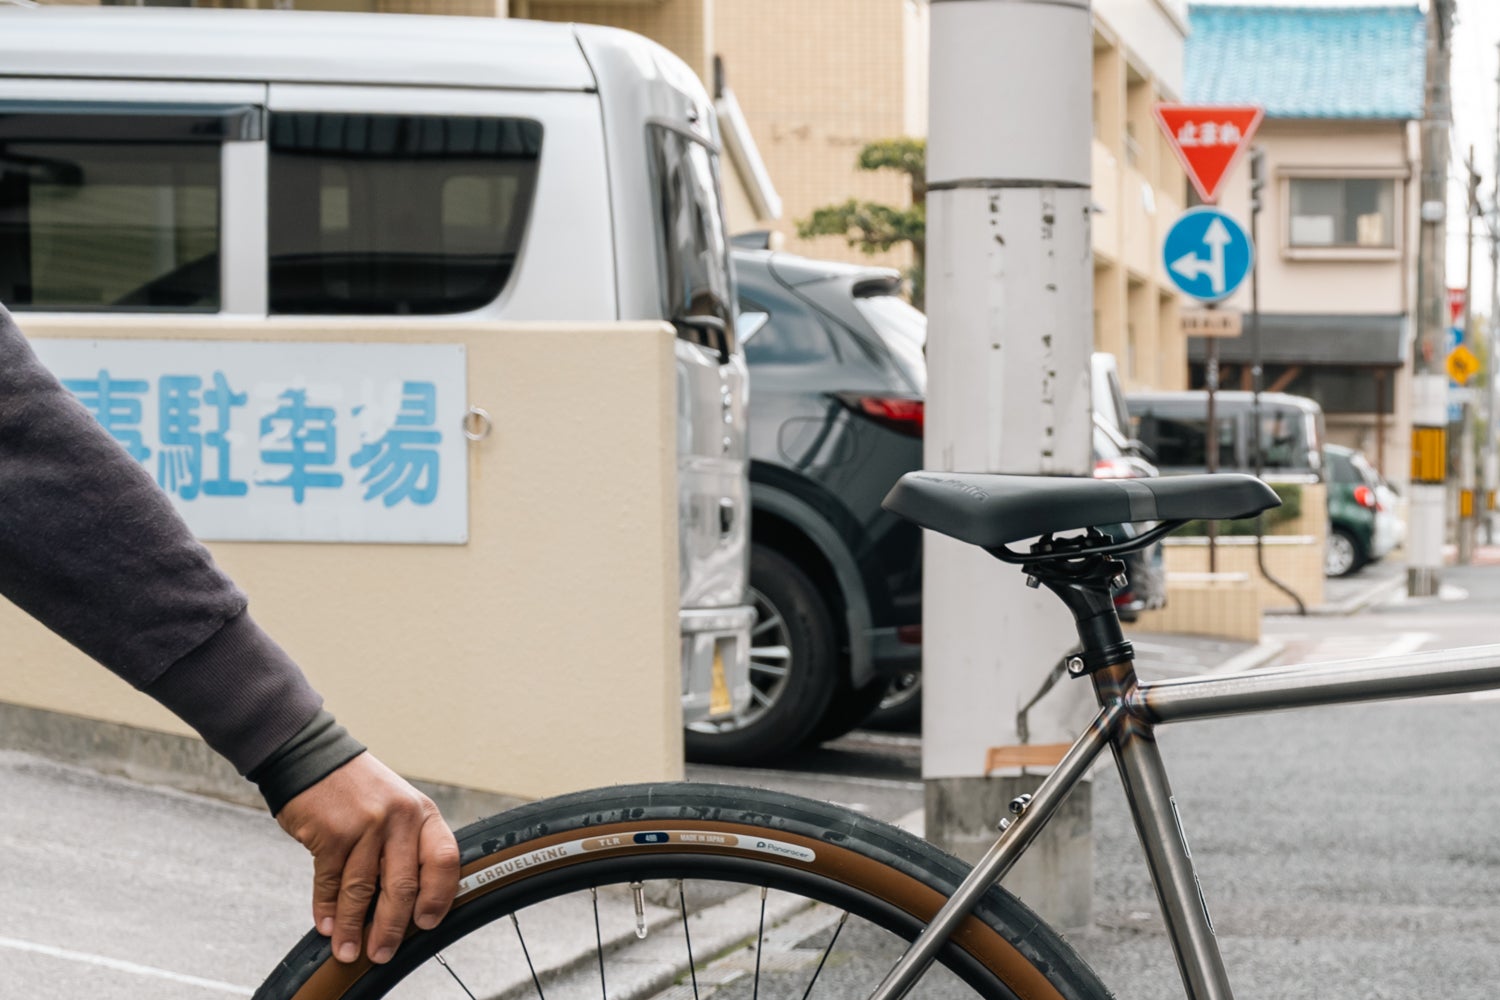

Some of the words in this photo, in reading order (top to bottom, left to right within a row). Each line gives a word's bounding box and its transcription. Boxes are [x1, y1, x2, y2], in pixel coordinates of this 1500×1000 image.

[1177, 120, 1241, 146] 止まれ
[599, 837, 620, 847] TLR
[680, 834, 697, 842] MADE
[706, 834, 725, 844] JAPAN
[767, 843, 810, 859] Panaracer
